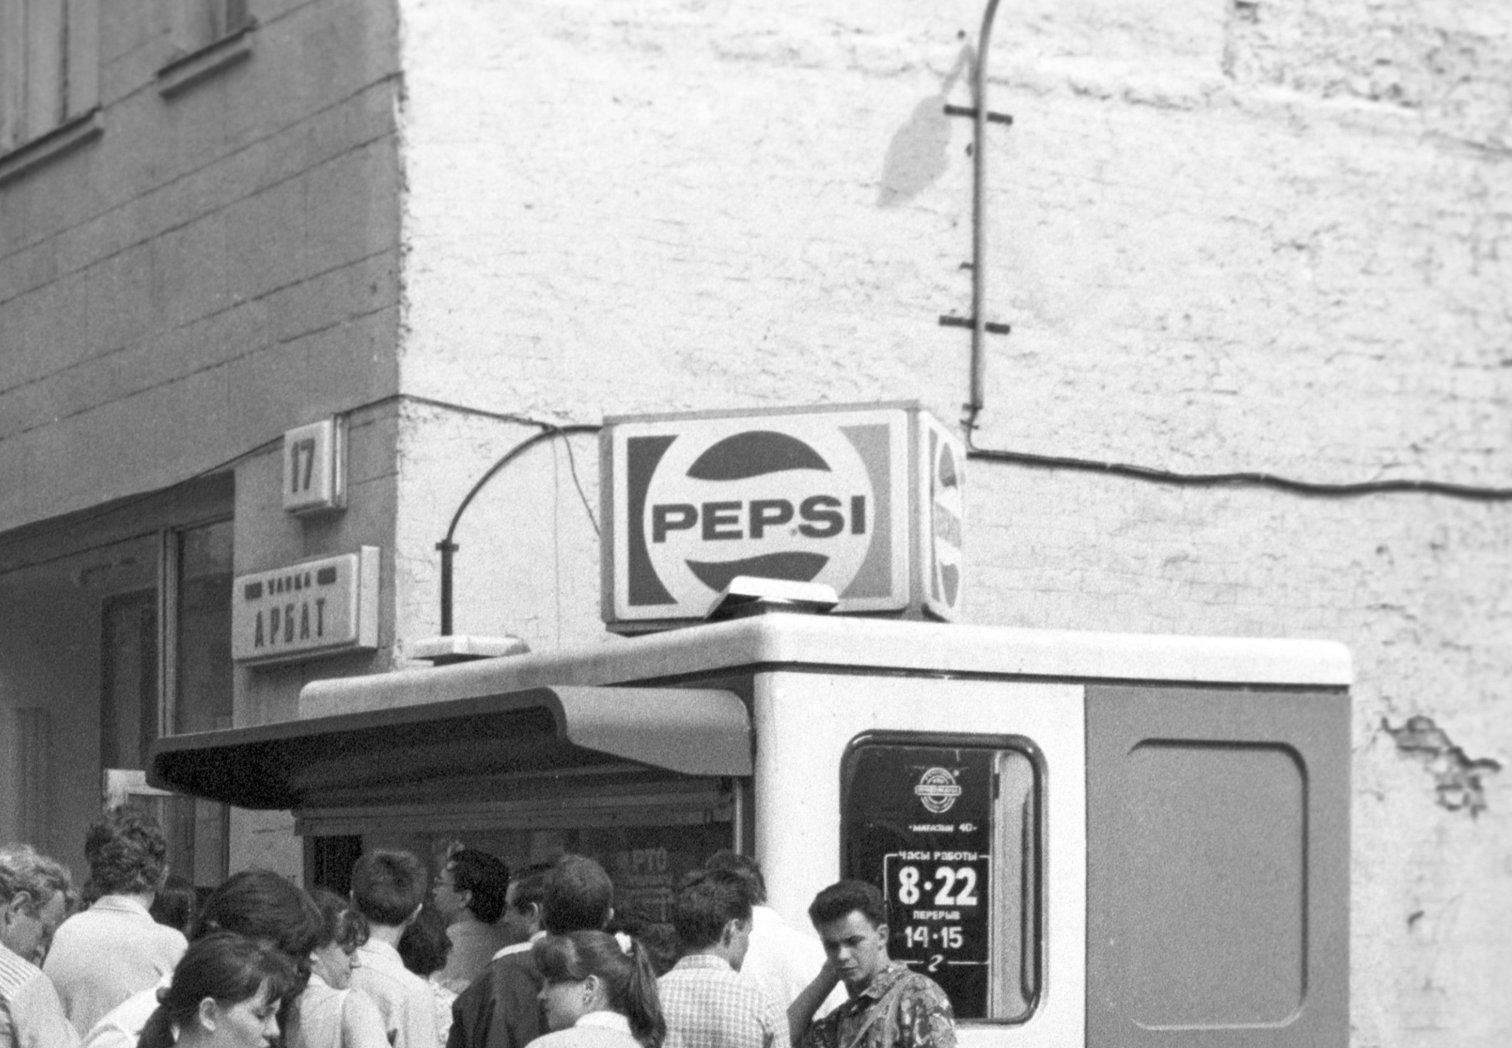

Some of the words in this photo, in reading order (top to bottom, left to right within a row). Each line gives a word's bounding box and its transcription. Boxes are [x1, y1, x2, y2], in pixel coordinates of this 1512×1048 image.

[291, 438, 316, 492] 17
[652, 495, 866, 543] PEPSI
[255, 598, 325, 648] АРБАТ
[913, 910, 961, 920] ПЕРЕРЫВ
